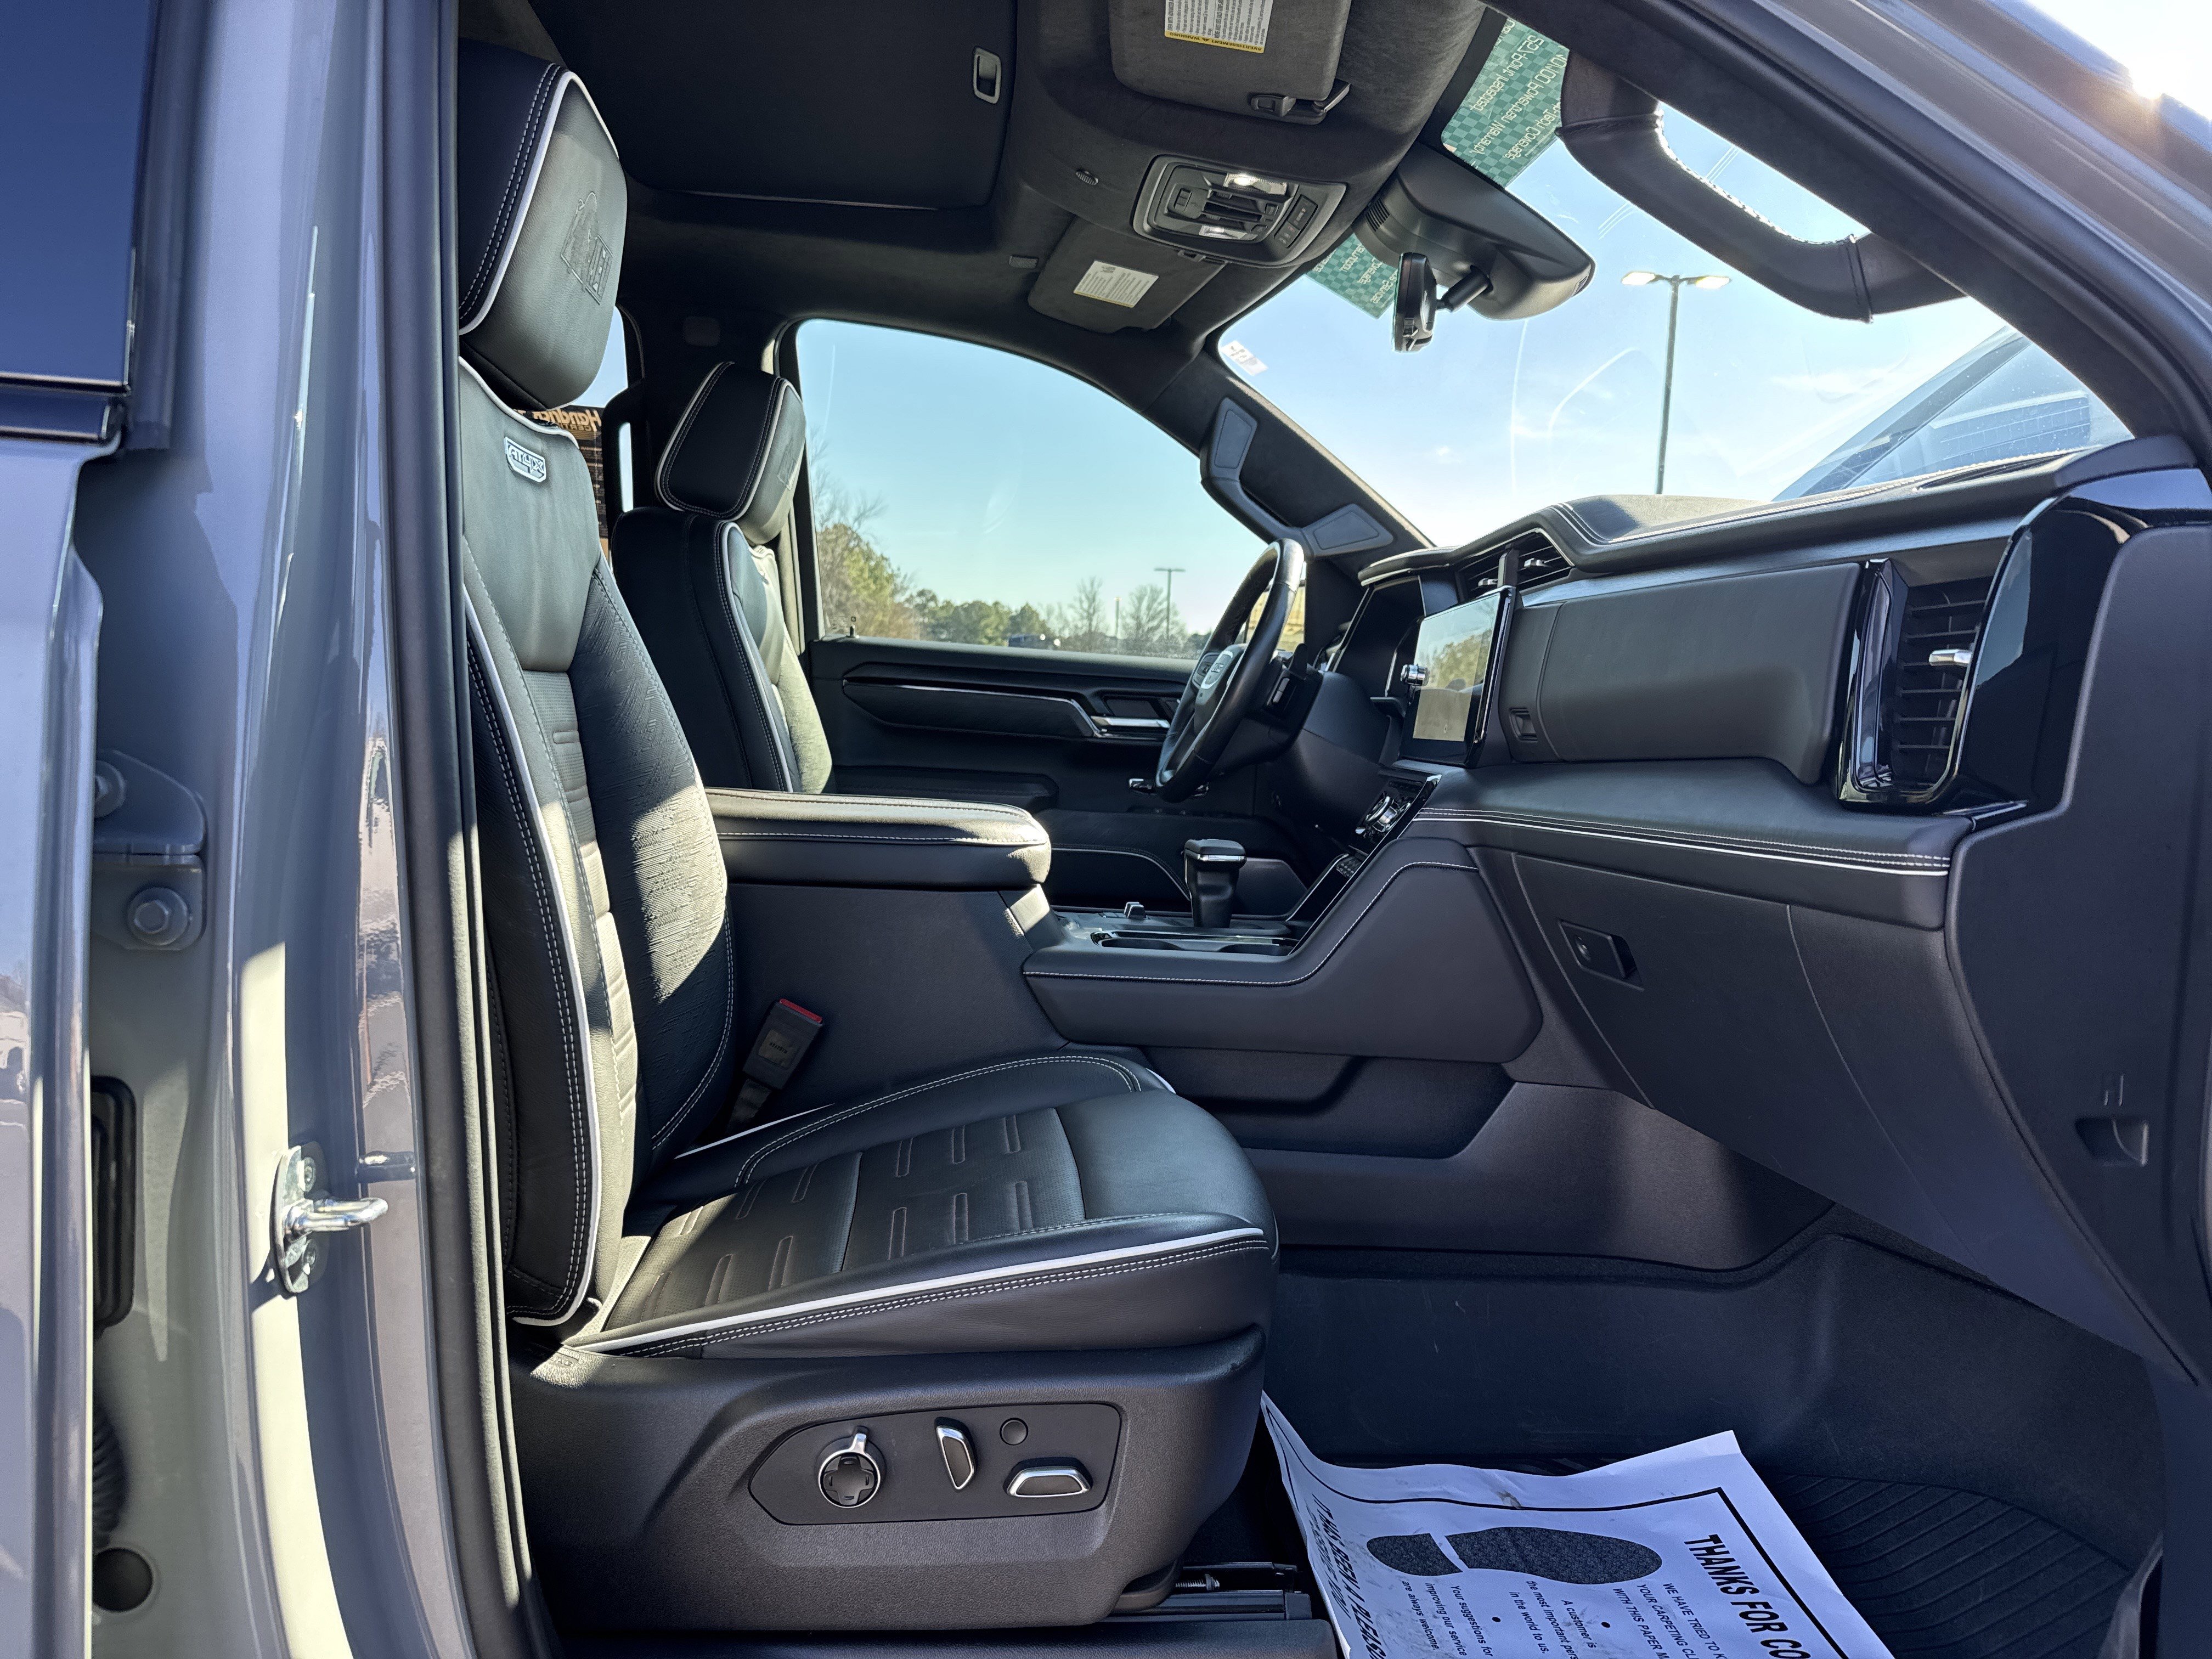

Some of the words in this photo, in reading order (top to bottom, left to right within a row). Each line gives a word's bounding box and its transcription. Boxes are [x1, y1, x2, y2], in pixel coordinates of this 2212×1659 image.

[1311, 1493, 1334, 1520] IT
[1317, 1509, 1345, 1547] HAS
[1325, 1536, 1361, 1589] BEEN
[1342, 1579, 1365, 1602] A
[1684, 1533, 1760, 1595] THANKS
[1730, 1601, 1788, 1633] FOR
[1324, 1569, 1352, 1620] YOU
[1402, 1581, 1413, 1592] are
[1408, 1593, 1424, 1616] always
[1425, 1583, 1447, 1615] improving
[1442, 1616, 1454, 1629] our
[1448, 1630, 1468, 1656] service
[1451, 1585, 1464, 1600] Your
[1459, 1602, 1486, 1644] suggestions
[1481, 1646, 1493, 1657] for
[1526, 1581, 1538, 1590] the
[1533, 1592, 1551, 1608] most
[1543, 1610, 1571, 1643] important
[1566, 1607, 1593, 1640] customer
[1613, 1588, 1633, 1604] WITH
[1626, 1606, 1645, 1622] THIS
[1637, 1624, 1663, 1650] PAPER
[1637, 1584, 1657, 1603] YOUR
[1651, 1605, 1688, 1646] CARPETING
[1663, 1583, 1679, 1594] WE
[1672, 1596, 1694, 1616] HAVE
[1688, 1618, 1711, 1639] TRIED
[1705, 1641, 1720, 1651] TO
[1347, 1595, 1386, 1659] PLEASU
[1514, 1599, 1526, 1610] the
[1521, 1612, 1541, 1630] world
[1538, 1643, 1549, 1654] us.
